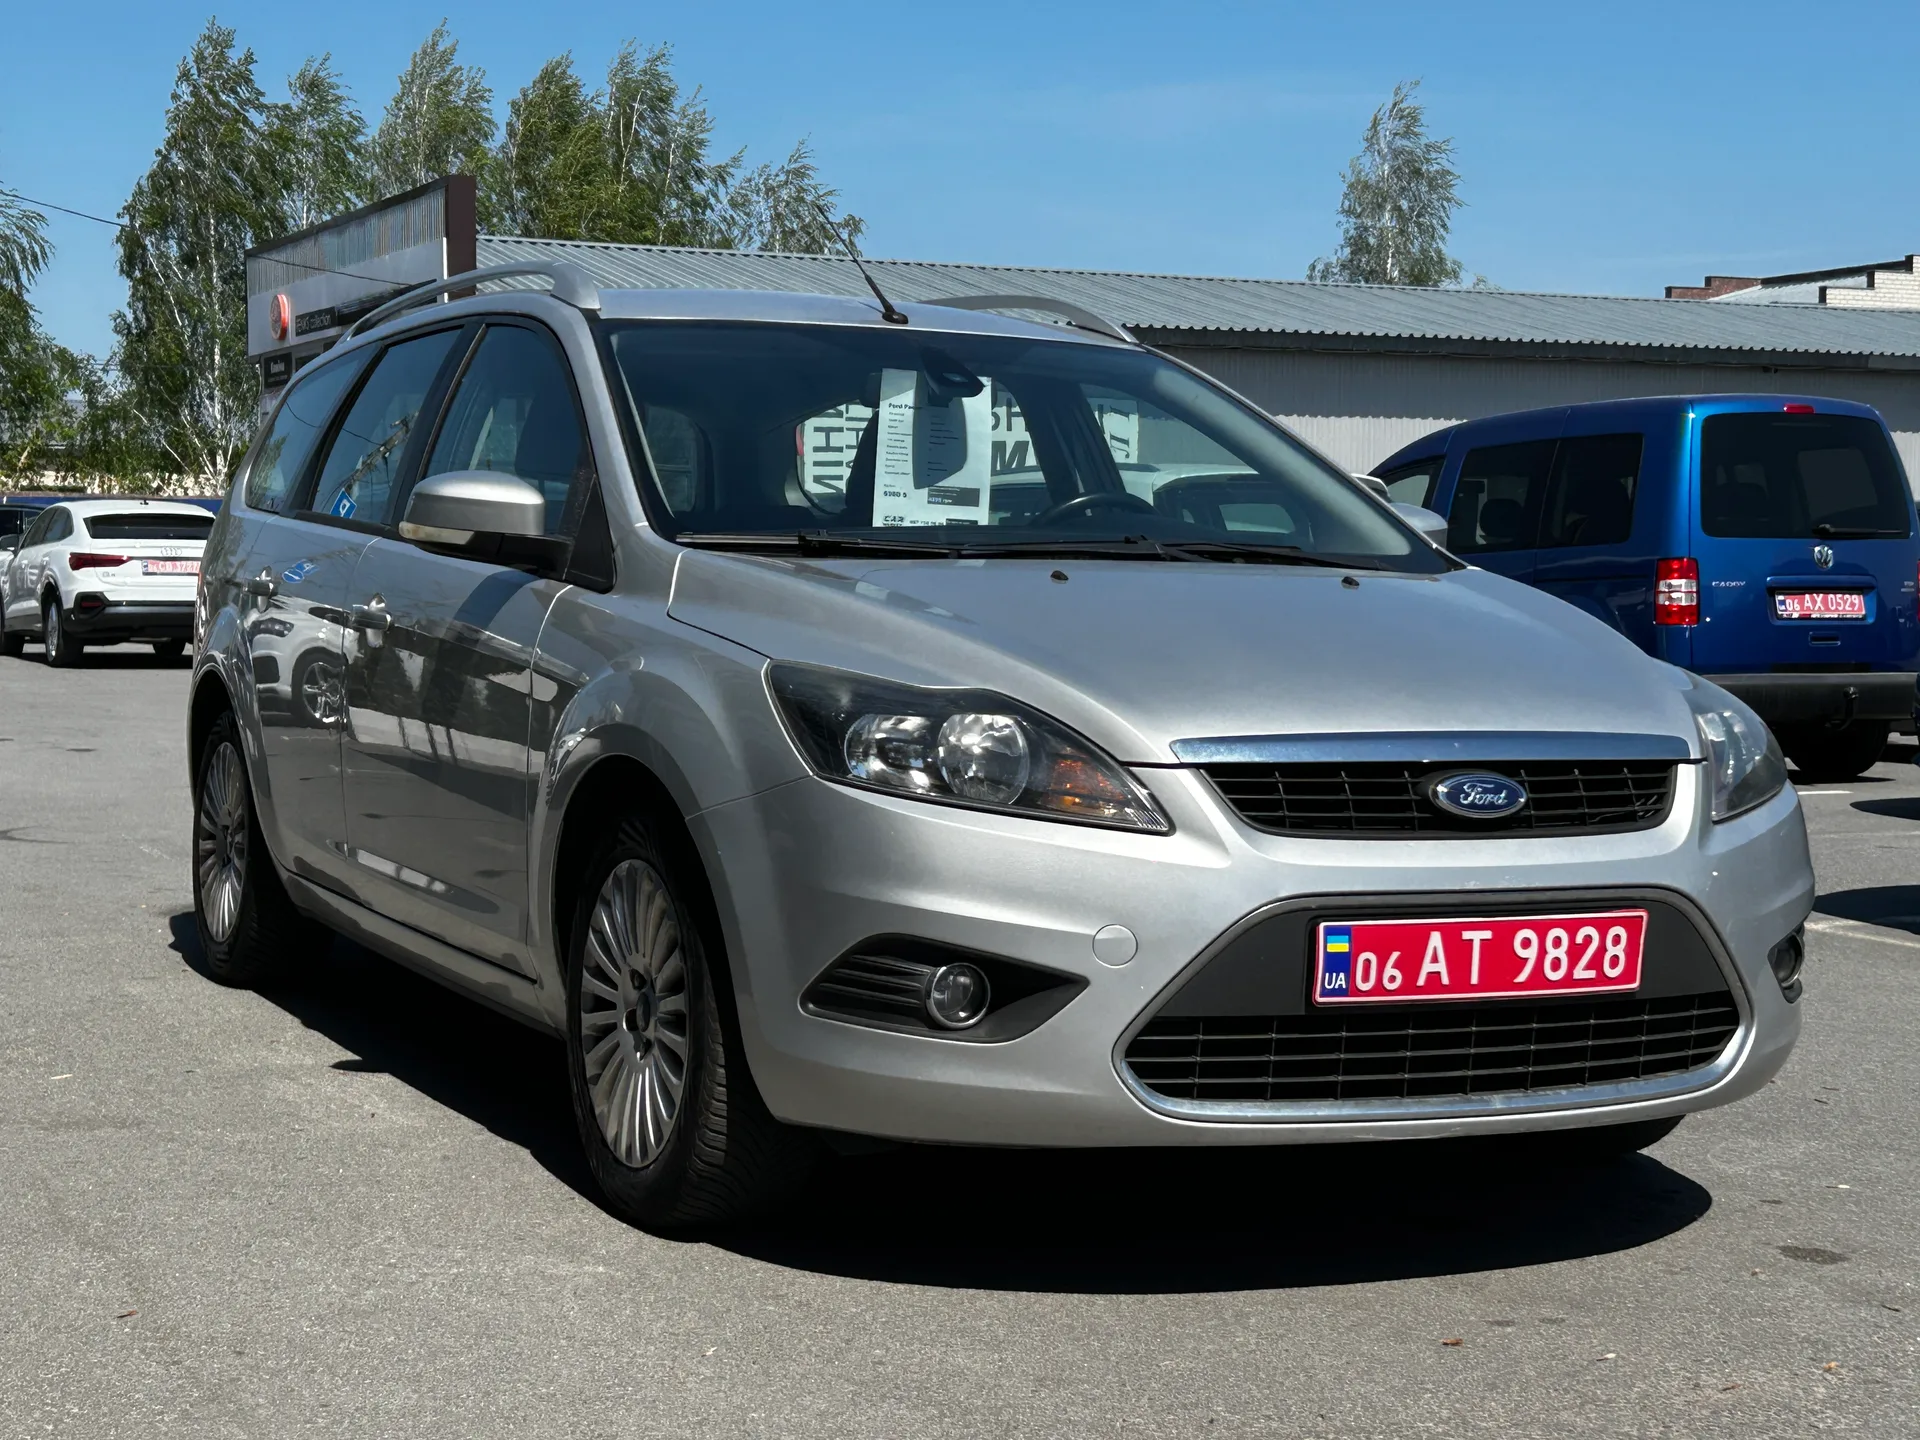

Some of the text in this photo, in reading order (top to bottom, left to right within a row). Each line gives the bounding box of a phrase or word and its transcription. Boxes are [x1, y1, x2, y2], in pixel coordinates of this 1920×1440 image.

[1785, 593, 1860, 611] 06 AX 0529
[1459, 782, 1508, 806] Ford
[1355, 925, 1628, 993] 06 AT 9828
[1324, 972, 1347, 990] UA
